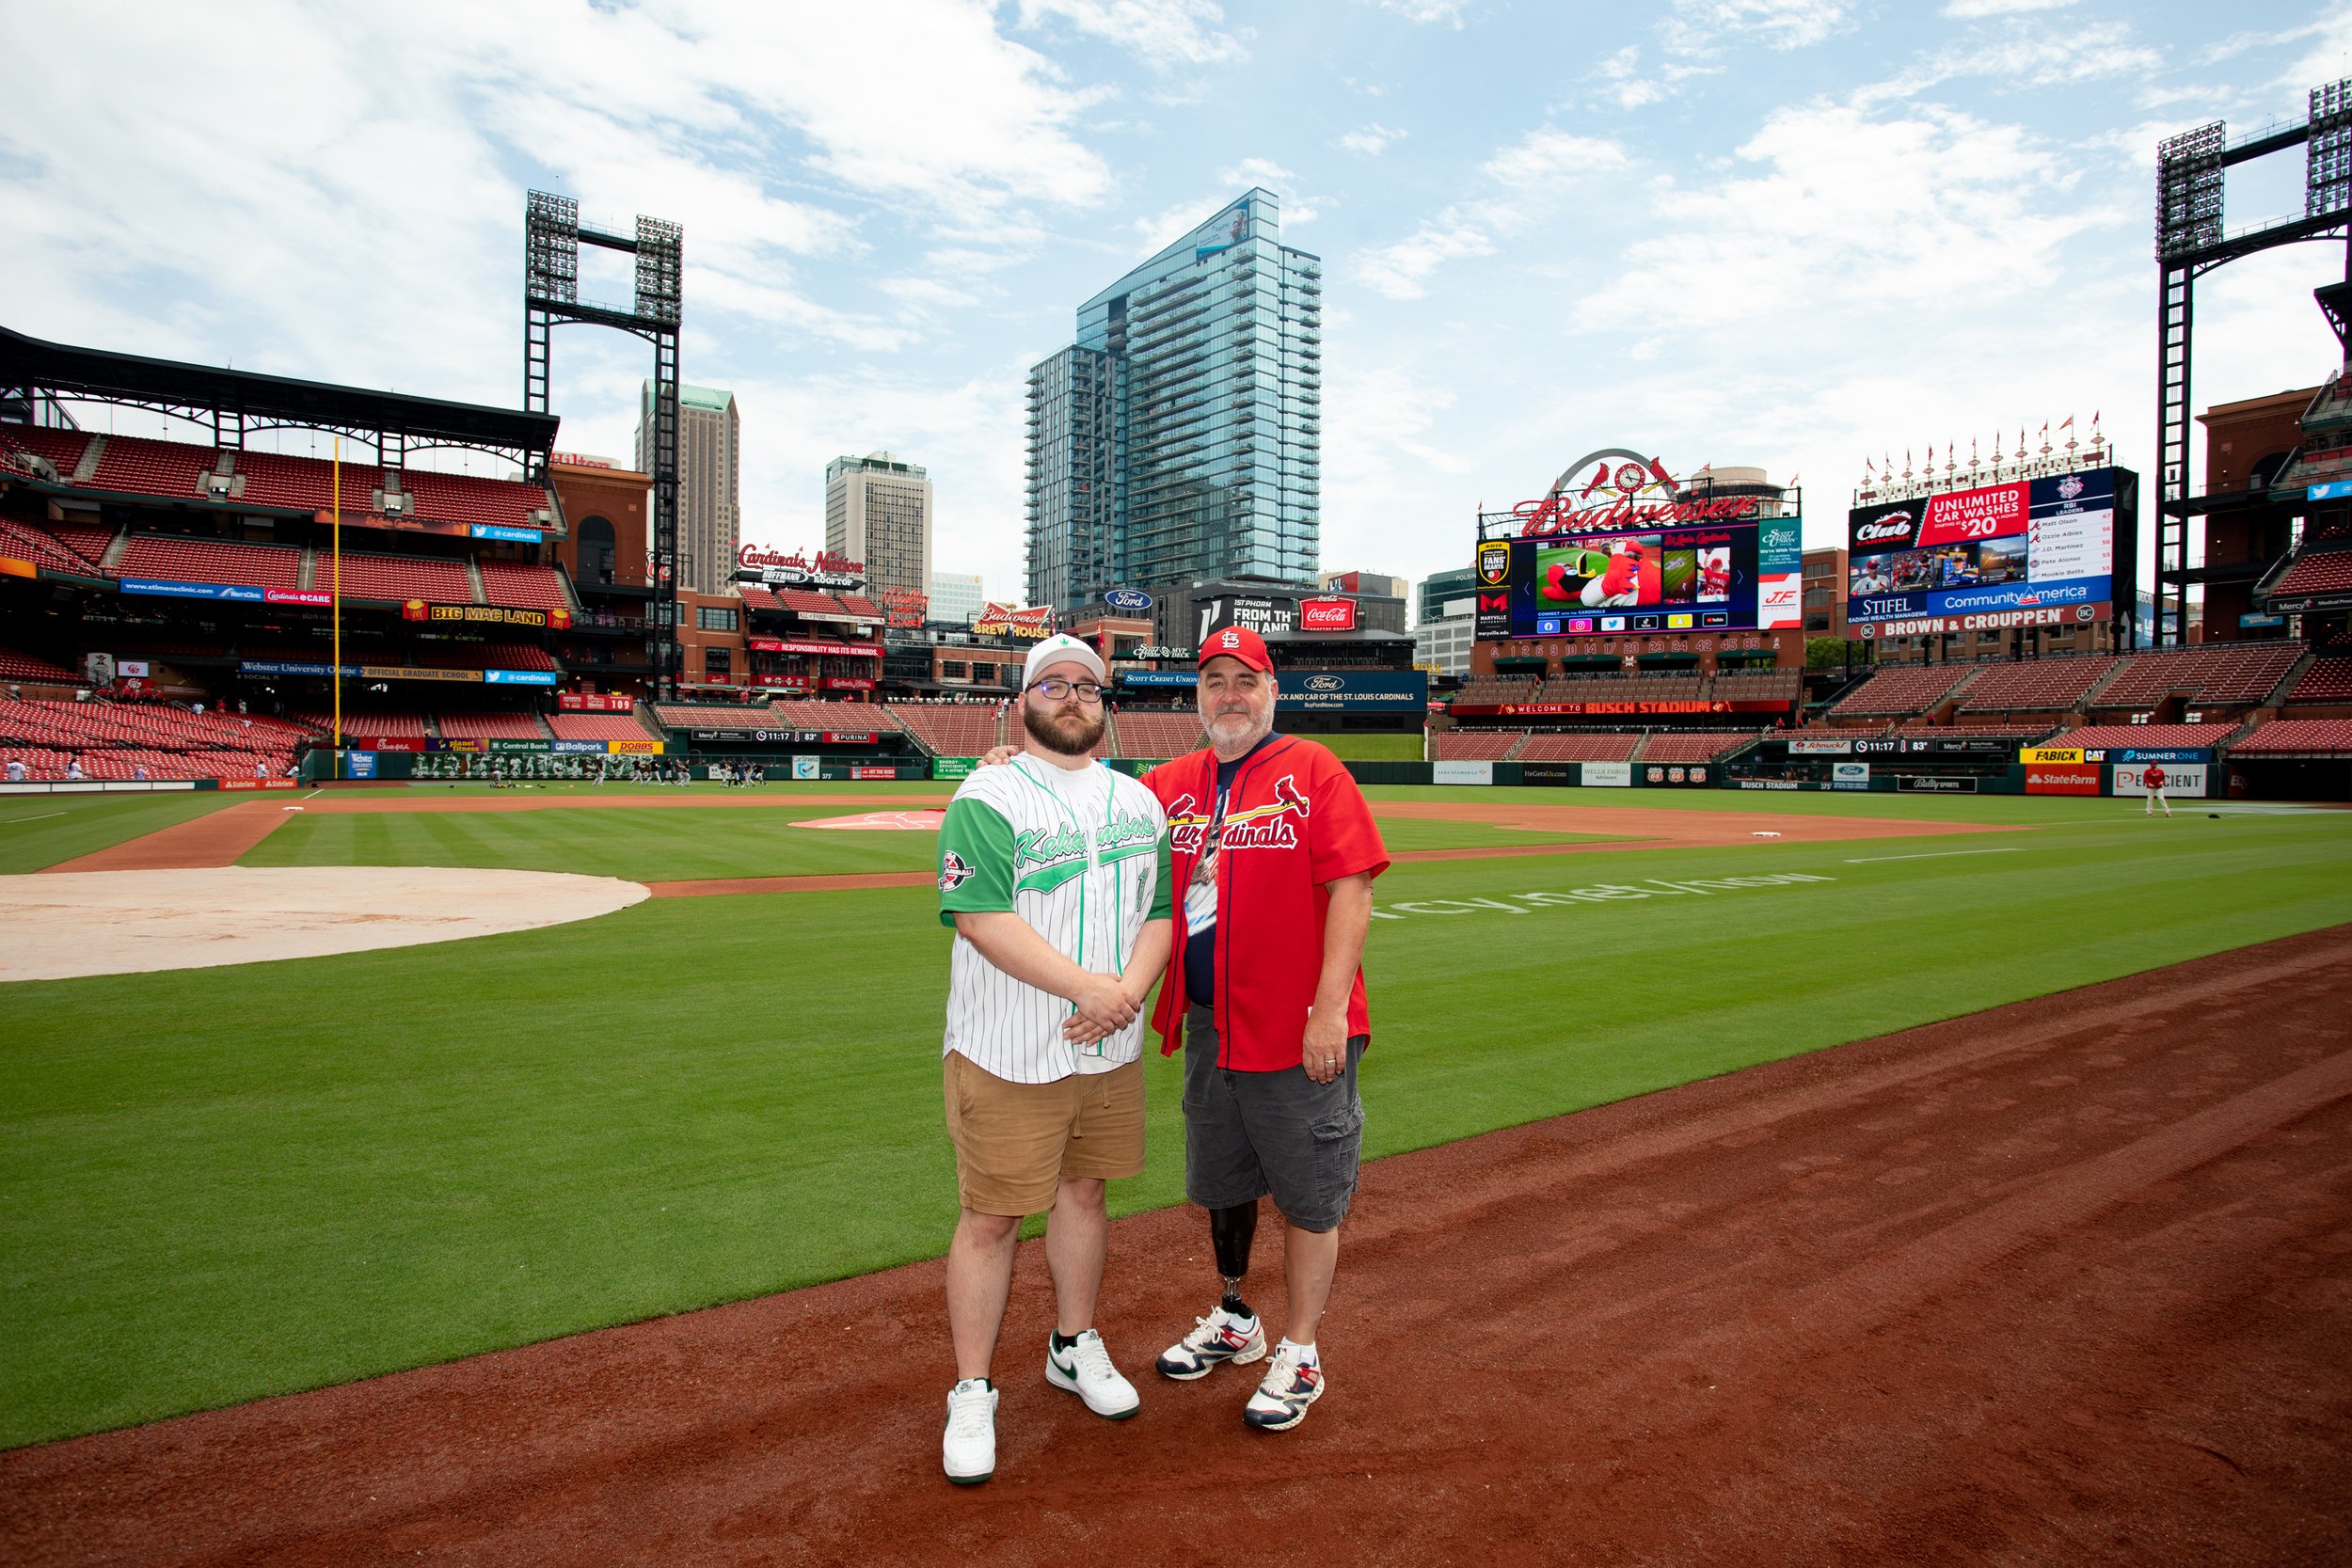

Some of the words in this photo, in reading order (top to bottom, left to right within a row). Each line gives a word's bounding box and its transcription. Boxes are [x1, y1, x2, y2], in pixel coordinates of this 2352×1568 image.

[550, 452, 611, 468] Hilton
[1874, 479, 1946, 499] WORLD
[1950, 454, 2085, 487] CHAMPIONS
[1933, 489, 2019, 514] UNLIMITED
[1513, 490, 1757, 537] Budweiser
[1933, 511, 1960, 523] CAR
[1963, 501, 2020, 519] WASHES
[2056, 507, 2084, 515] LEADERS
[1856, 520, 1911, 541] Club
[1961, 516, 1996, 537] $20
[494, 530, 537, 540] @cardinals
[739, 543, 807, 569] Cardinals
[806, 550, 864, 574] Nation
[1484, 556, 1506, 564] FANS'
[762, 570, 801, 581] HOFFMANN
[814, 576, 852, 586] ROOFTOP
[125, 583, 214, 594] www.stlmensclinic.com
[267, 590, 299, 601] Cardinals
[307, 594, 330, 603] CARE
[1115, 592, 1143, 607] Ford
[1863, 597, 1912, 614] STIFEL
[431, 607, 463, 620] BIG
[465, 608, 503, 622] MAC
[504, 610, 546, 626] LAND
[979, 606, 1050, 625] Budweiser
[1233, 608, 1271, 622] FROM
[1274, 610, 1292, 623] TH
[1307, 608, 1348, 622] Coca-Cola
[1869, 613, 1894, 622] WEALTH
[2079, 607, 2092, 619] BC
[1262, 622, 1290, 634] AND
[1884, 618, 1944, 636] BROWN
[1948, 620, 1960, 631] &
[1963, 609, 2060, 629] CROUPPEN
[974, 623, 1009, 636] BREW
[1011, 626, 1051, 640] HOUSE
[782, 643, 827, 654] RESPONSIBILITY
[850, 648, 879, 657] REWARDS.
[1510, 646, 1516, 657] 1
[1521, 646, 1530, 657] 2
[1535, 645, 1543, 656] 6
[1550, 644, 1558, 656] 9
[1565, 644, 1577, 656] 10
[1583, 643, 1597, 655] 14
[1603, 642, 1616, 654] 17
[1624, 642, 1640, 654] 20
[1648, 641, 1665, 652] 23
[1671, 641, 1688, 652] 24
[1695, 640, 1712, 651] 42
[1721, 639, 1738, 650] 45
[1743, 638, 1760, 649] 85
[243, 662, 278, 672] Webster
[281, 663, 326, 675] University
[327, 665, 357, 674] Online
[368, 669, 401, 677] OFFICIAL
[403, 670, 439, 678] GRADUATE
[442, 671, 469, 679] SCHOOL
[508, 673, 551, 682] @cardinals
[1149, 674, 1174, 683] CREDIT
[1311, 676, 1338, 689] Ford
[612, 700, 629, 709] 109
[1585, 703, 1635, 714] BUSCH
[1639, 702, 1710, 713] STADIUM
[449, 739, 475, 748] planet
[502, 741, 529, 750] Central
[565, 741, 602, 751] Ballpark
[1869, 742, 1895, 751] 11:17
[1913, 741, 1928, 751] 83°
[352, 753, 373, 763] Webster
[2035, 751, 2077, 761] FABICK
[2085, 750, 2106, 761] CAT
[1524, 769, 1567, 778] HeGetsUs.com
[1842, 767, 1860, 775] Ford
[1740, 781, 1764, 789] BUSCH
[1914, 778, 1940, 790] Bally
[2116, 771, 2201, 788] PECIENT
[1169, 815, 1298, 854] Cardinals
[1136, 867, 1150, 911] 1
[1370, 873, 1838, 921] rcy.net/now
